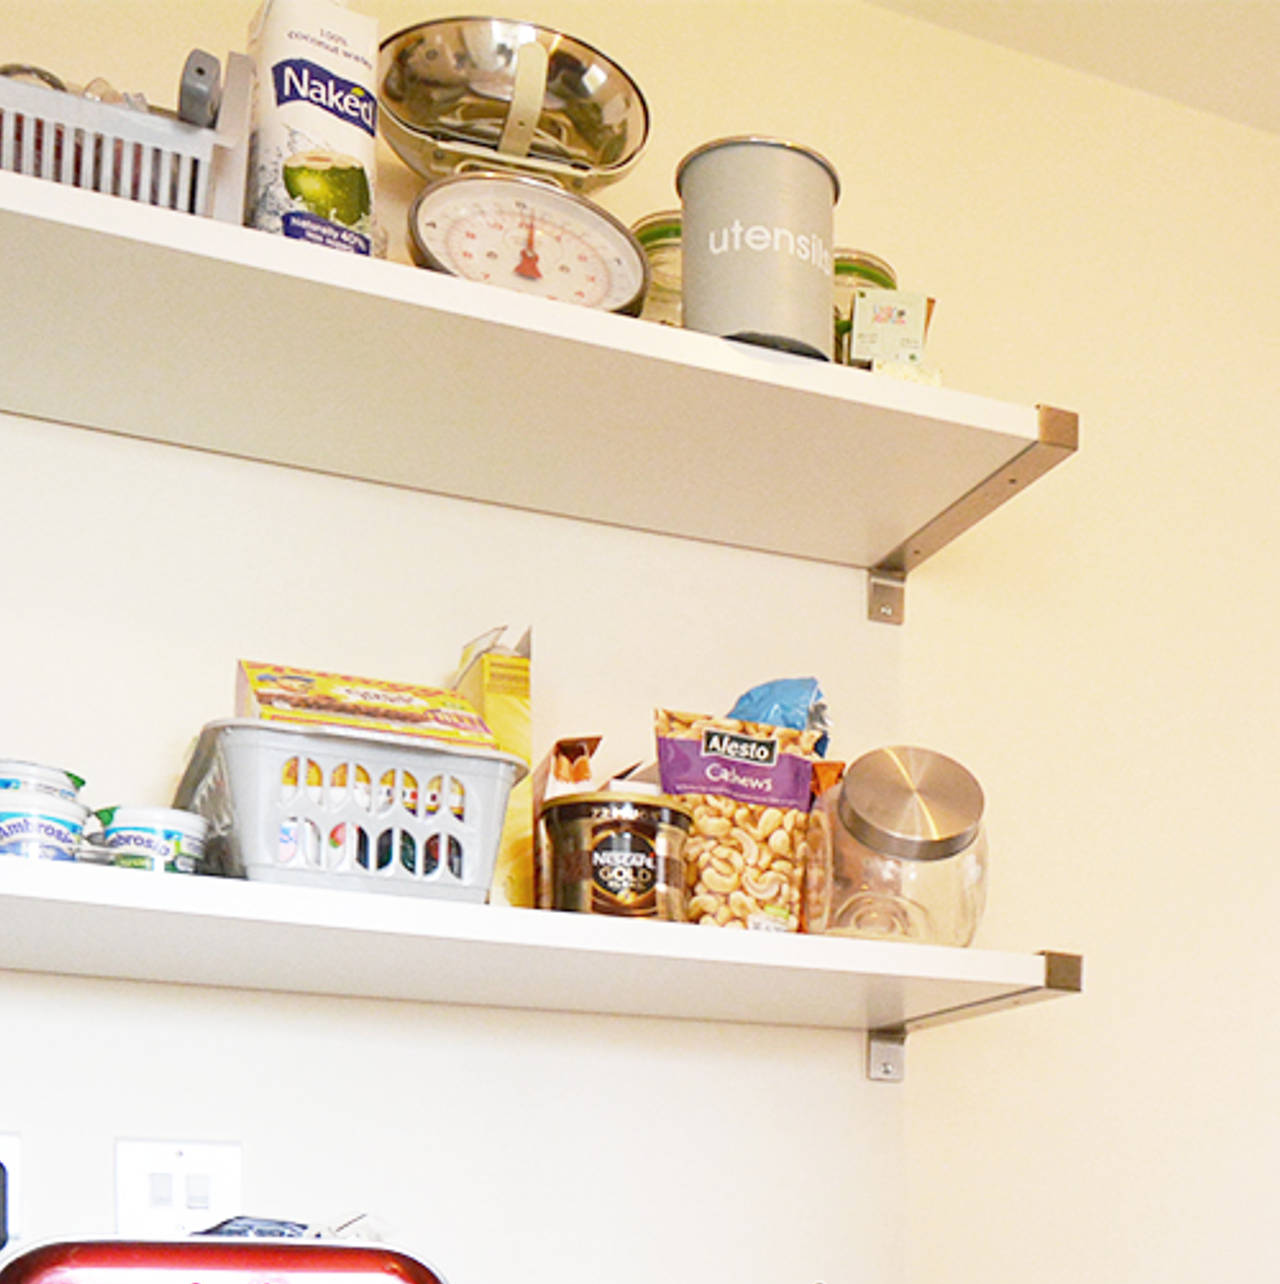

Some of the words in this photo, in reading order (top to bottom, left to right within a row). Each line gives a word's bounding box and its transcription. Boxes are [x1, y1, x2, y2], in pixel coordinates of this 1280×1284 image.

[284, 66, 373, 128] Naked
[708, 219, 831, 276] utensils
[708, 734, 771, 761] Alesto
[705, 762, 773, 792] Cashews
